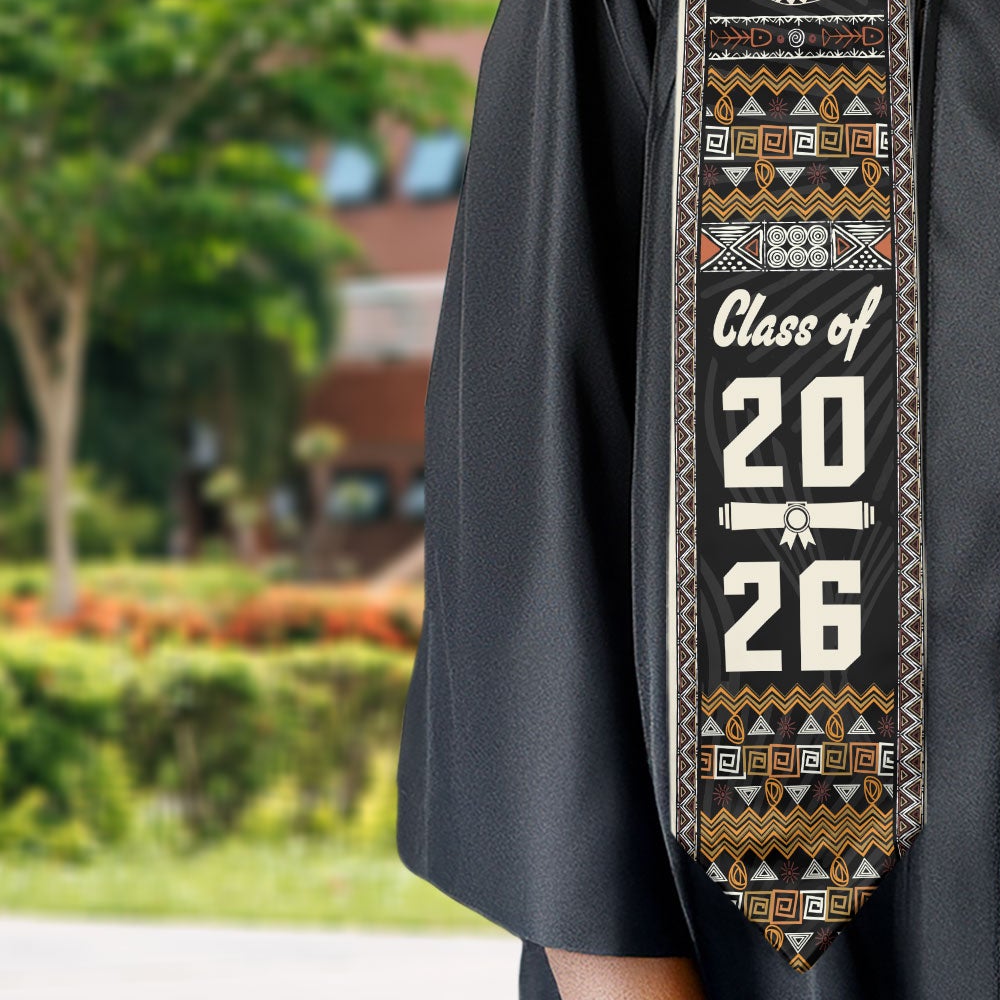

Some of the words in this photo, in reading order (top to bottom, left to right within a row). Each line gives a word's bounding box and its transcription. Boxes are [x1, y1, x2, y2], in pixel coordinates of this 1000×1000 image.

[712, 288, 819, 347] Class
[827, 284, 883, 362] of
[722, 375, 866, 488] 20
[723, 559, 862, 673] 26
